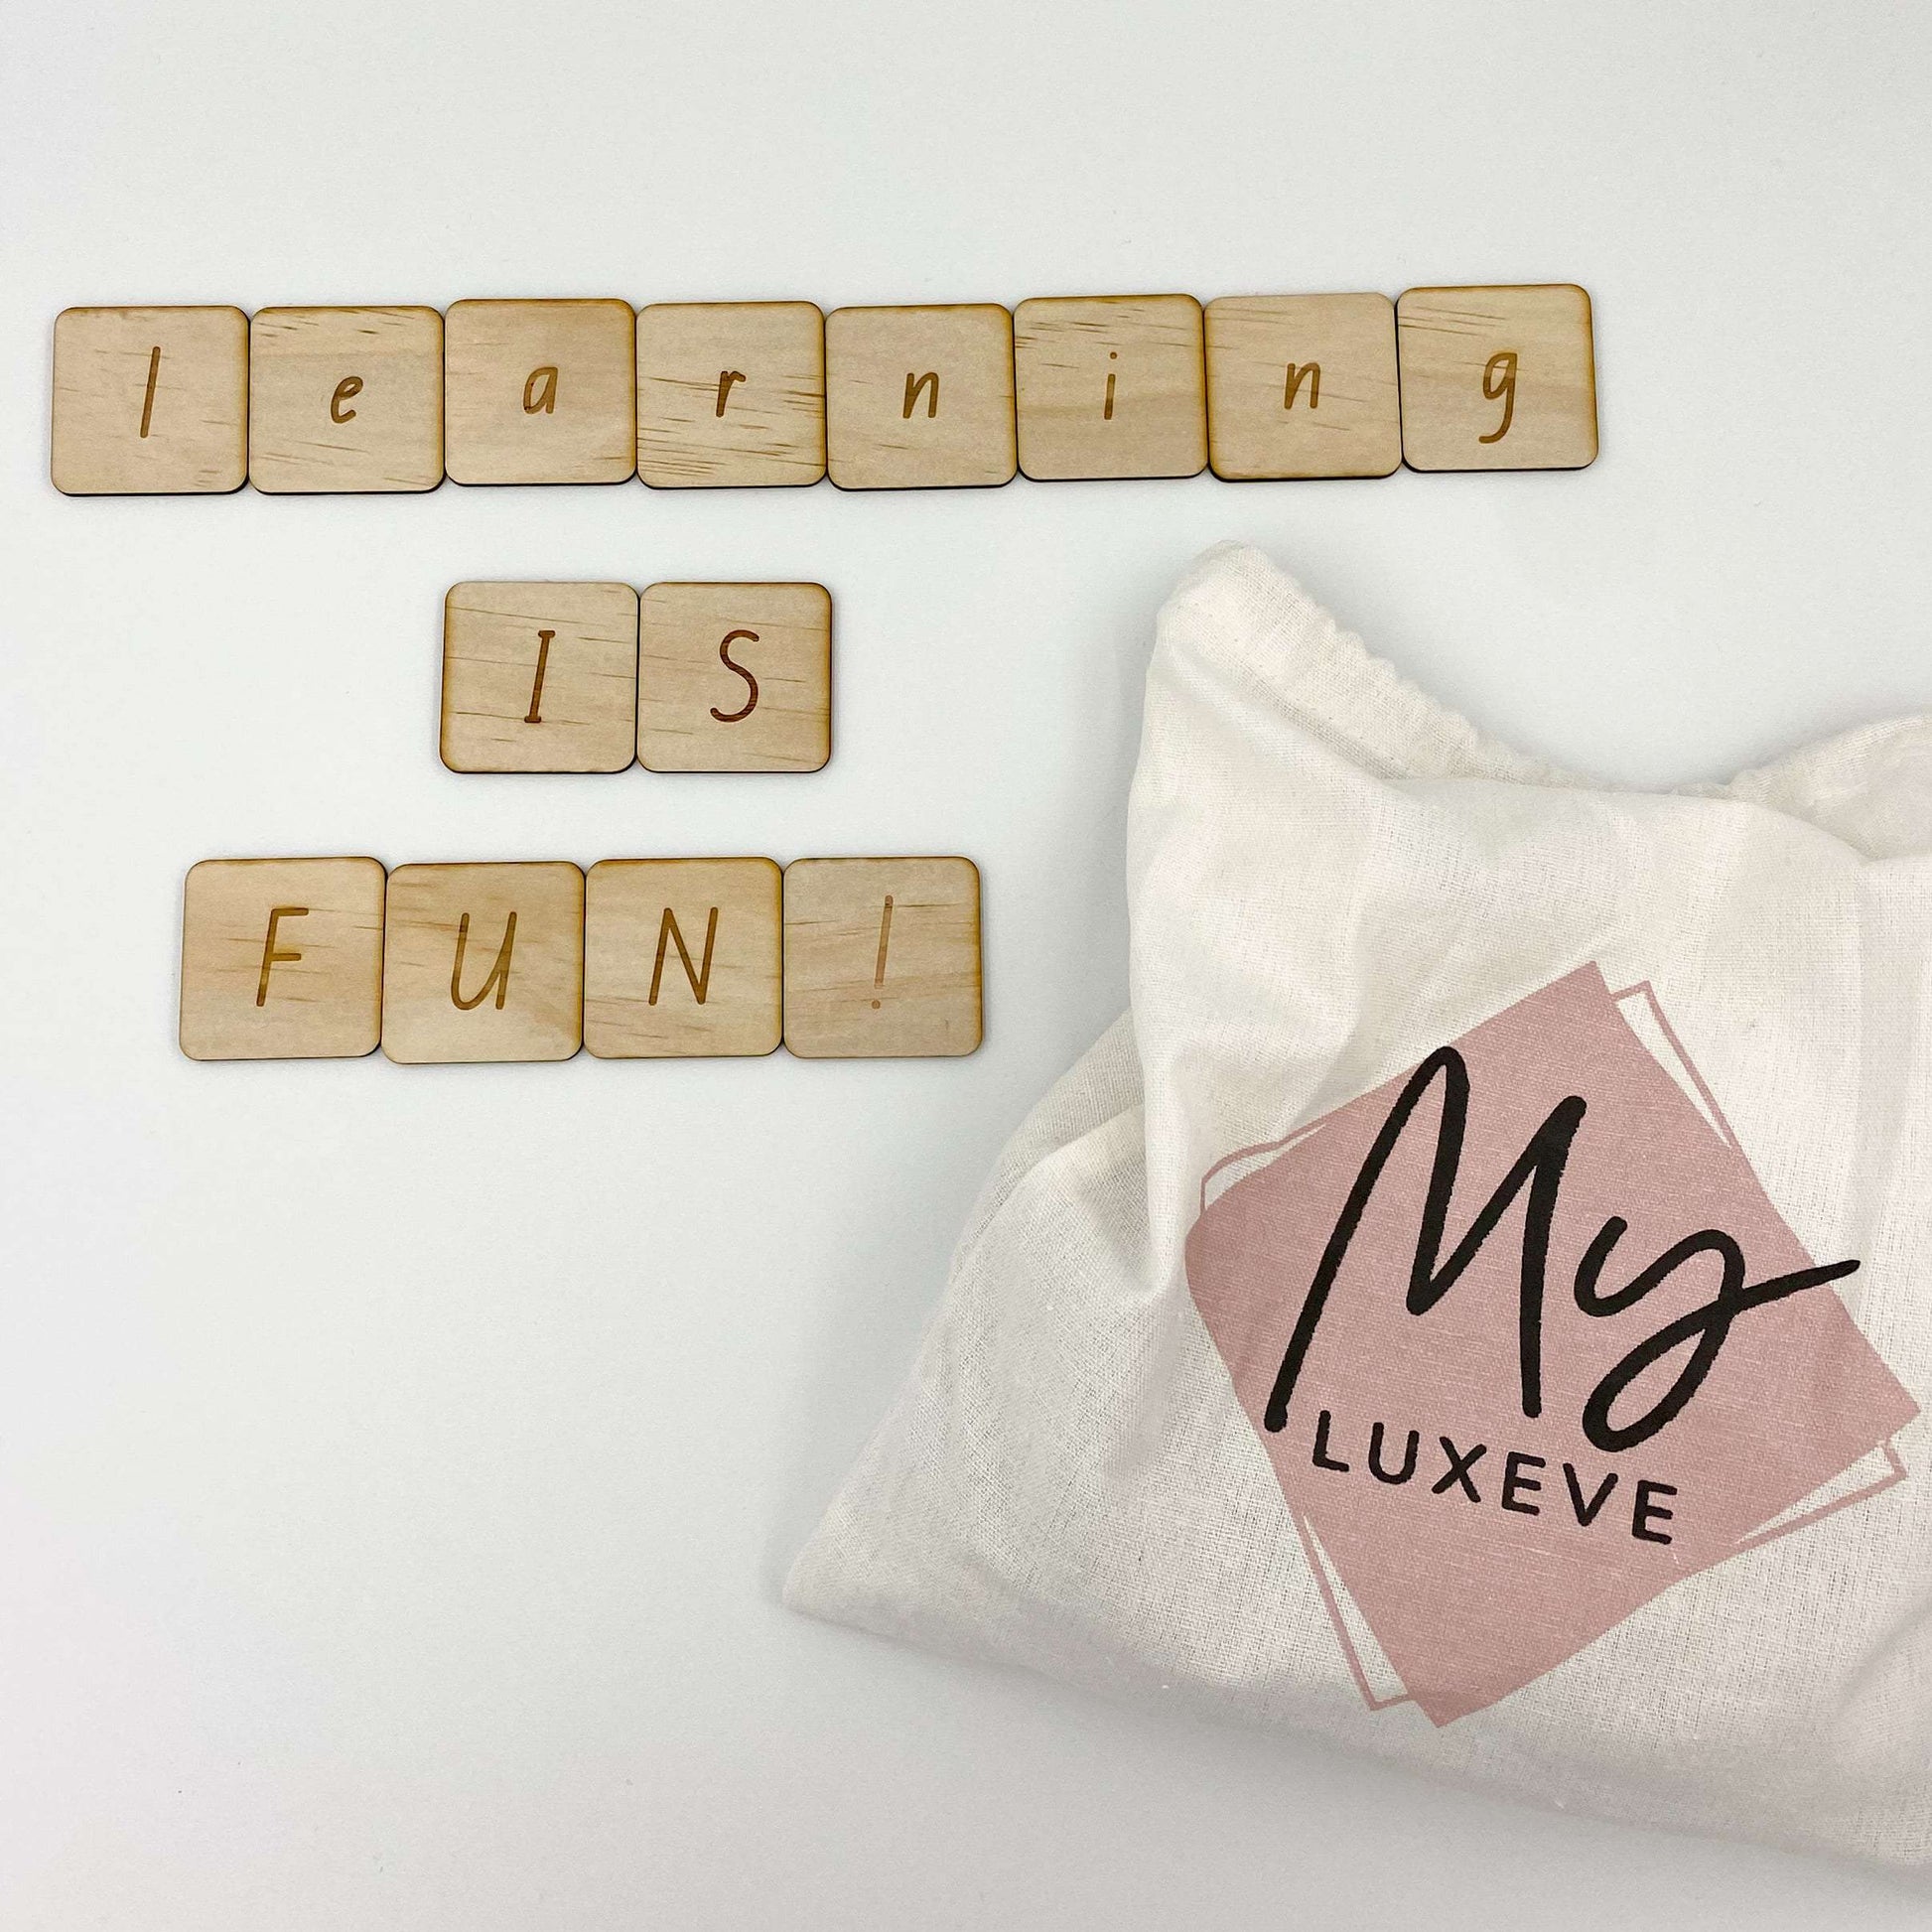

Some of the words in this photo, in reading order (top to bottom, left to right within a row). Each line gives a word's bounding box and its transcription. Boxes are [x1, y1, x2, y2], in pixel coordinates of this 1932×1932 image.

[140, 345, 1519, 444] learning
[524, 629, 760, 724] IS
[255, 895, 895, 1011] FUN!
[1263, 1045, 1862, 1453] My
[1311, 1409, 1678, 1545] LUXEVE
